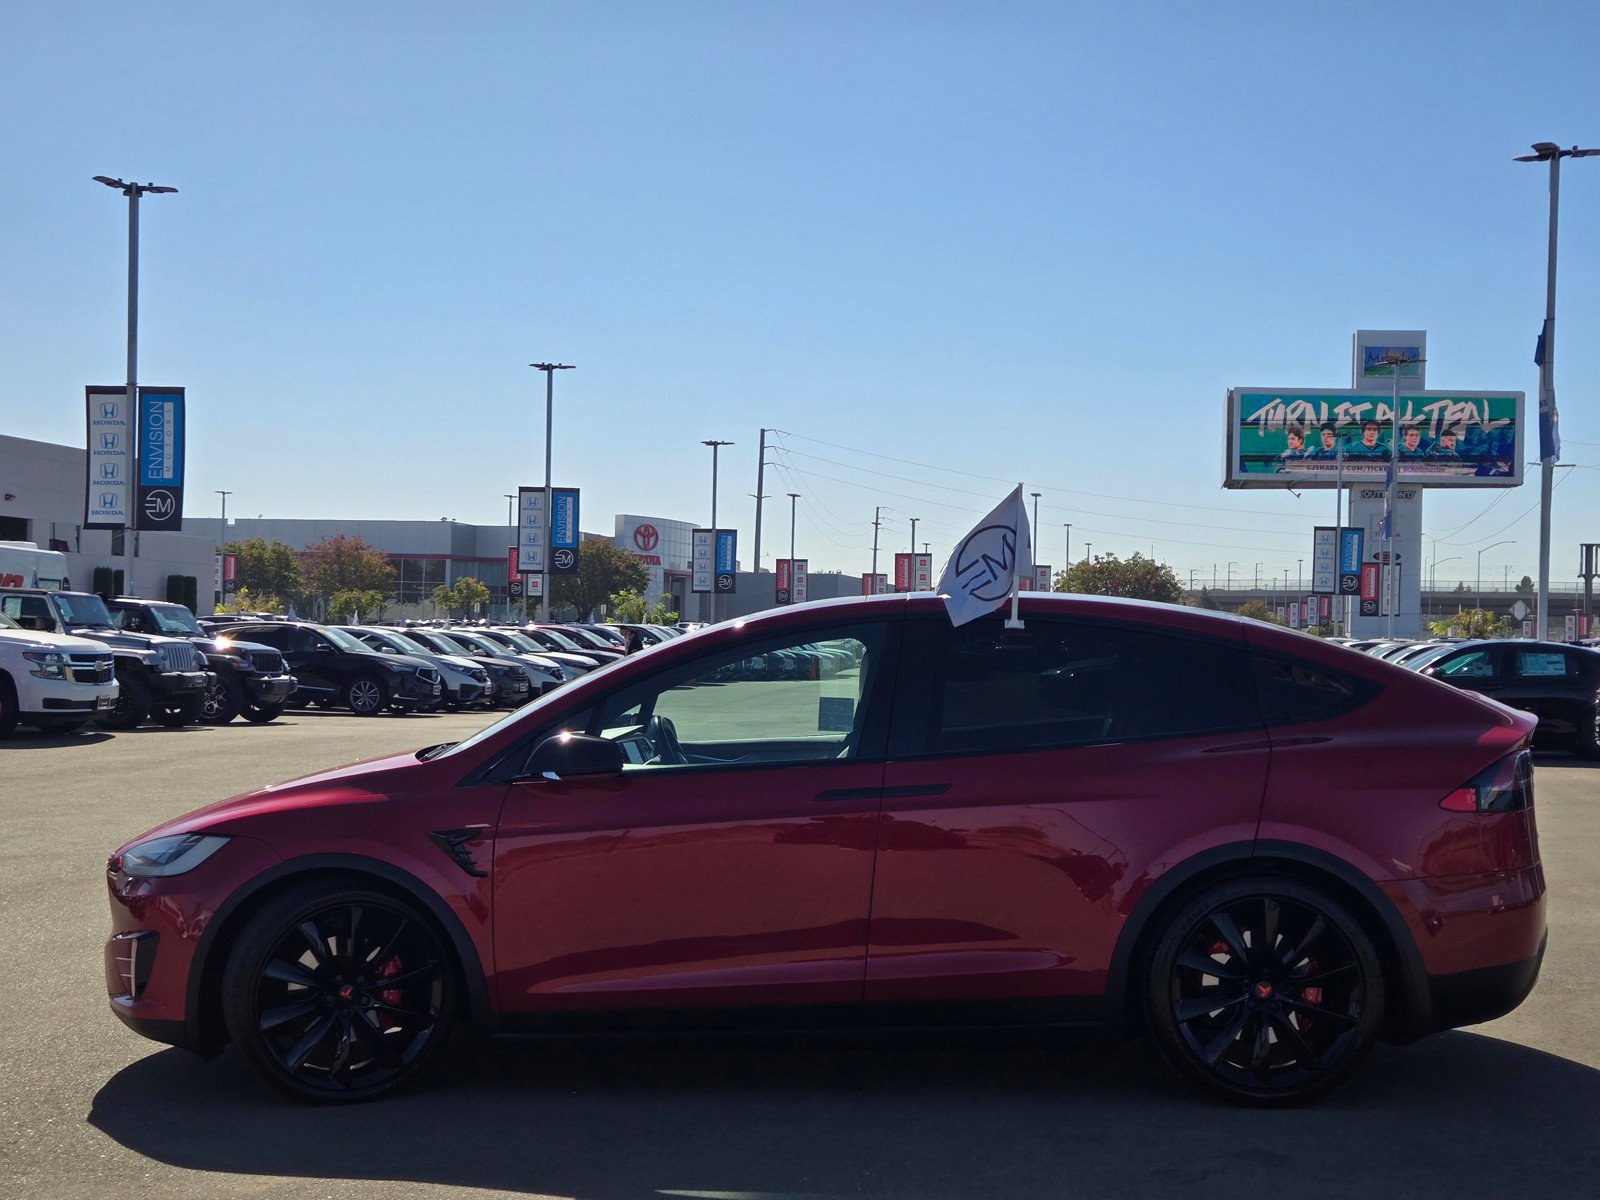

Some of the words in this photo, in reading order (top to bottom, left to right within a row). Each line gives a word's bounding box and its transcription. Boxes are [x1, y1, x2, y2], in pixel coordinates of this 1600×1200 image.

[148, 401, 163, 479] ENVISION
[1246, 398, 1329, 437] TURN
[1333, 401, 1373, 428] IT
[1376, 400, 1426, 425] AL
[1422, 399, 1511, 441] TEAL
[556, 496, 567, 544] ENVISION
[720, 535, 728, 571] ENVISION
[1344, 533, 1353, 571] ENVISION
